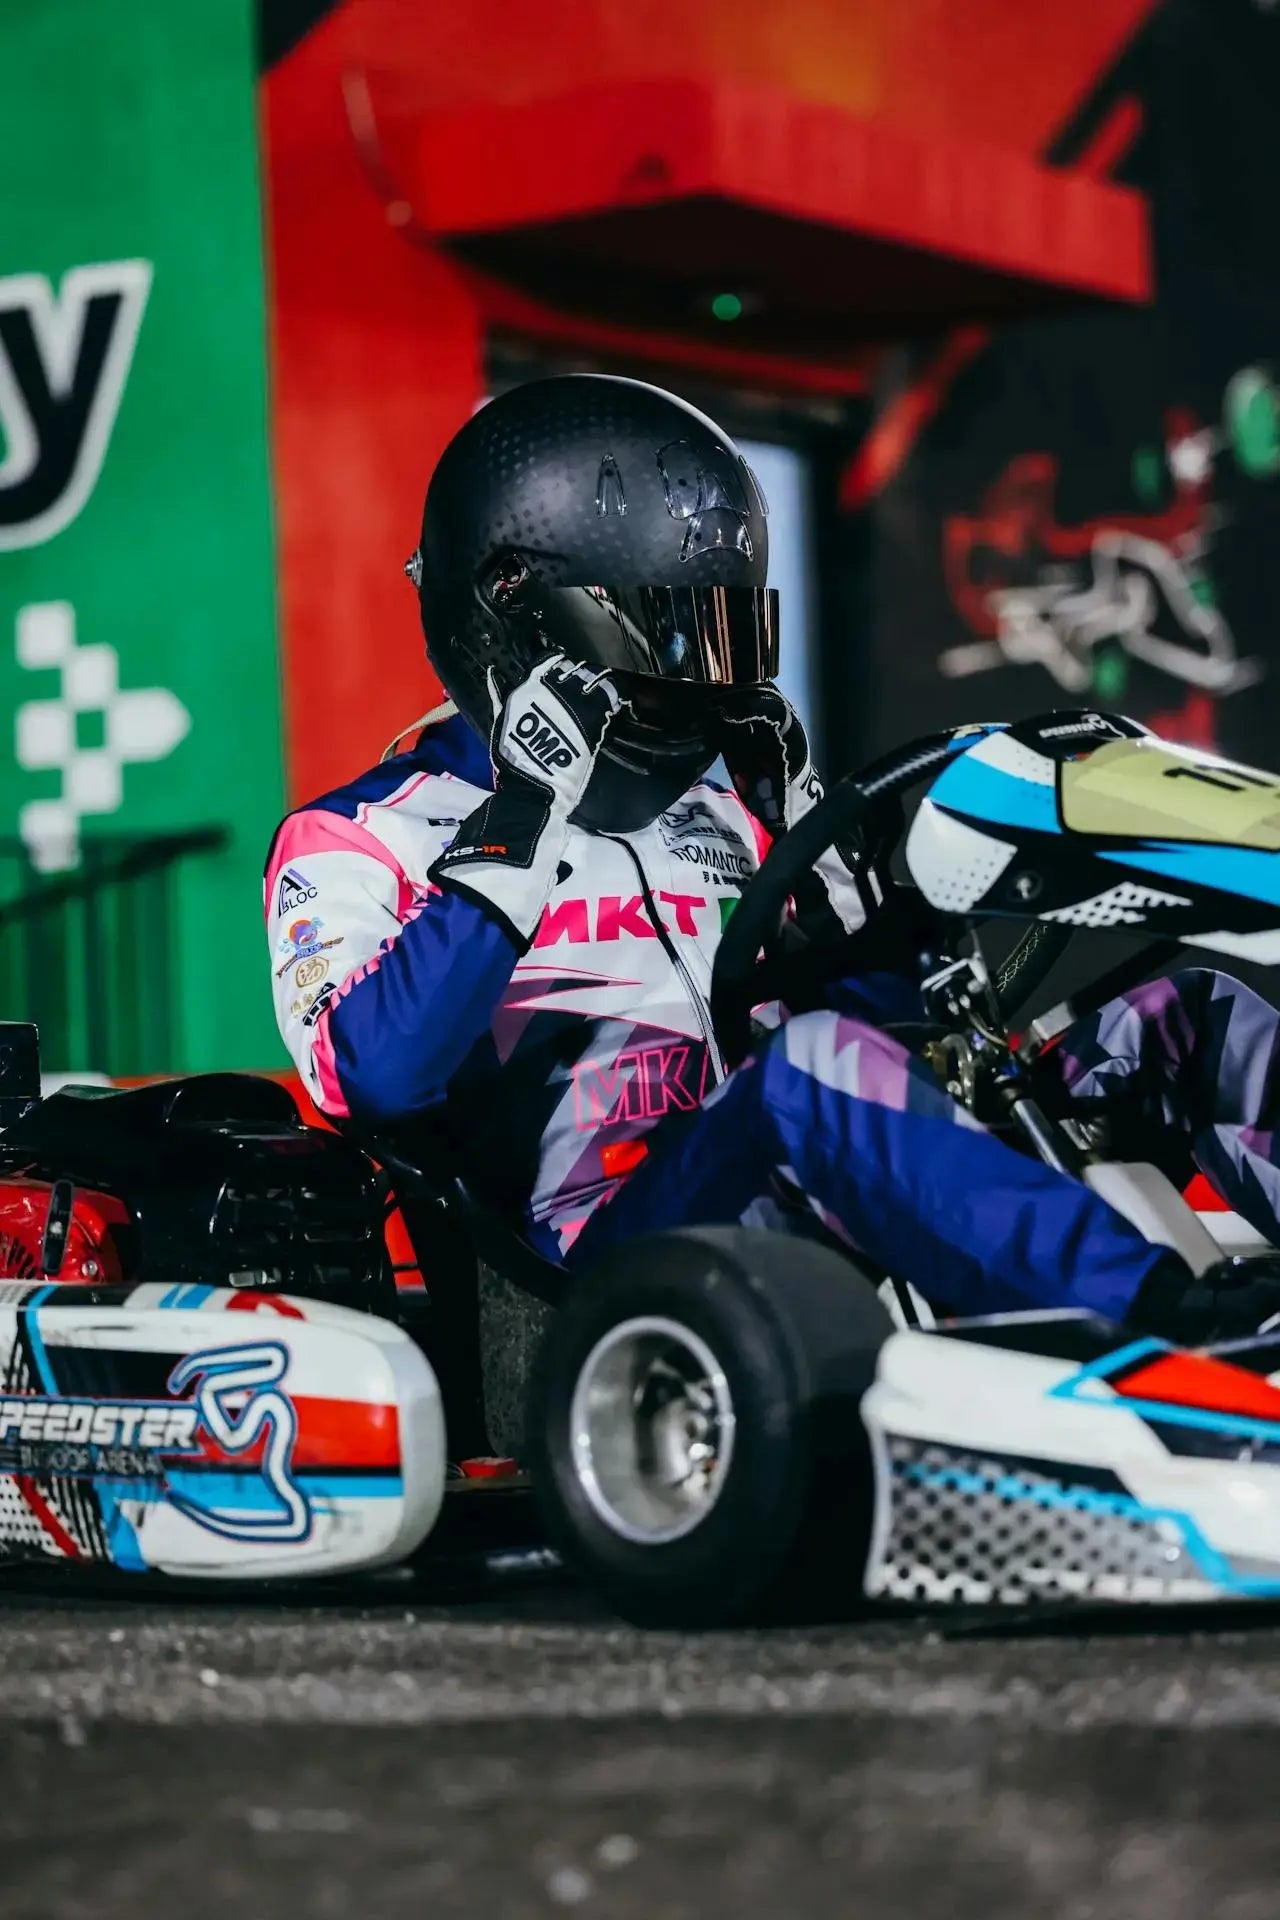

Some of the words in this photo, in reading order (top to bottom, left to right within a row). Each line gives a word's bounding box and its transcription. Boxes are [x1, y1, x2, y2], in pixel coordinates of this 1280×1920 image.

[516, 712, 572, 768] OMP
[669, 844, 753, 878] ROMANTIC
[533, 889, 707, 949] MKT
[571, 1046, 709, 1133] MK
[0, 1400, 198, 1448] PEEDSTER
